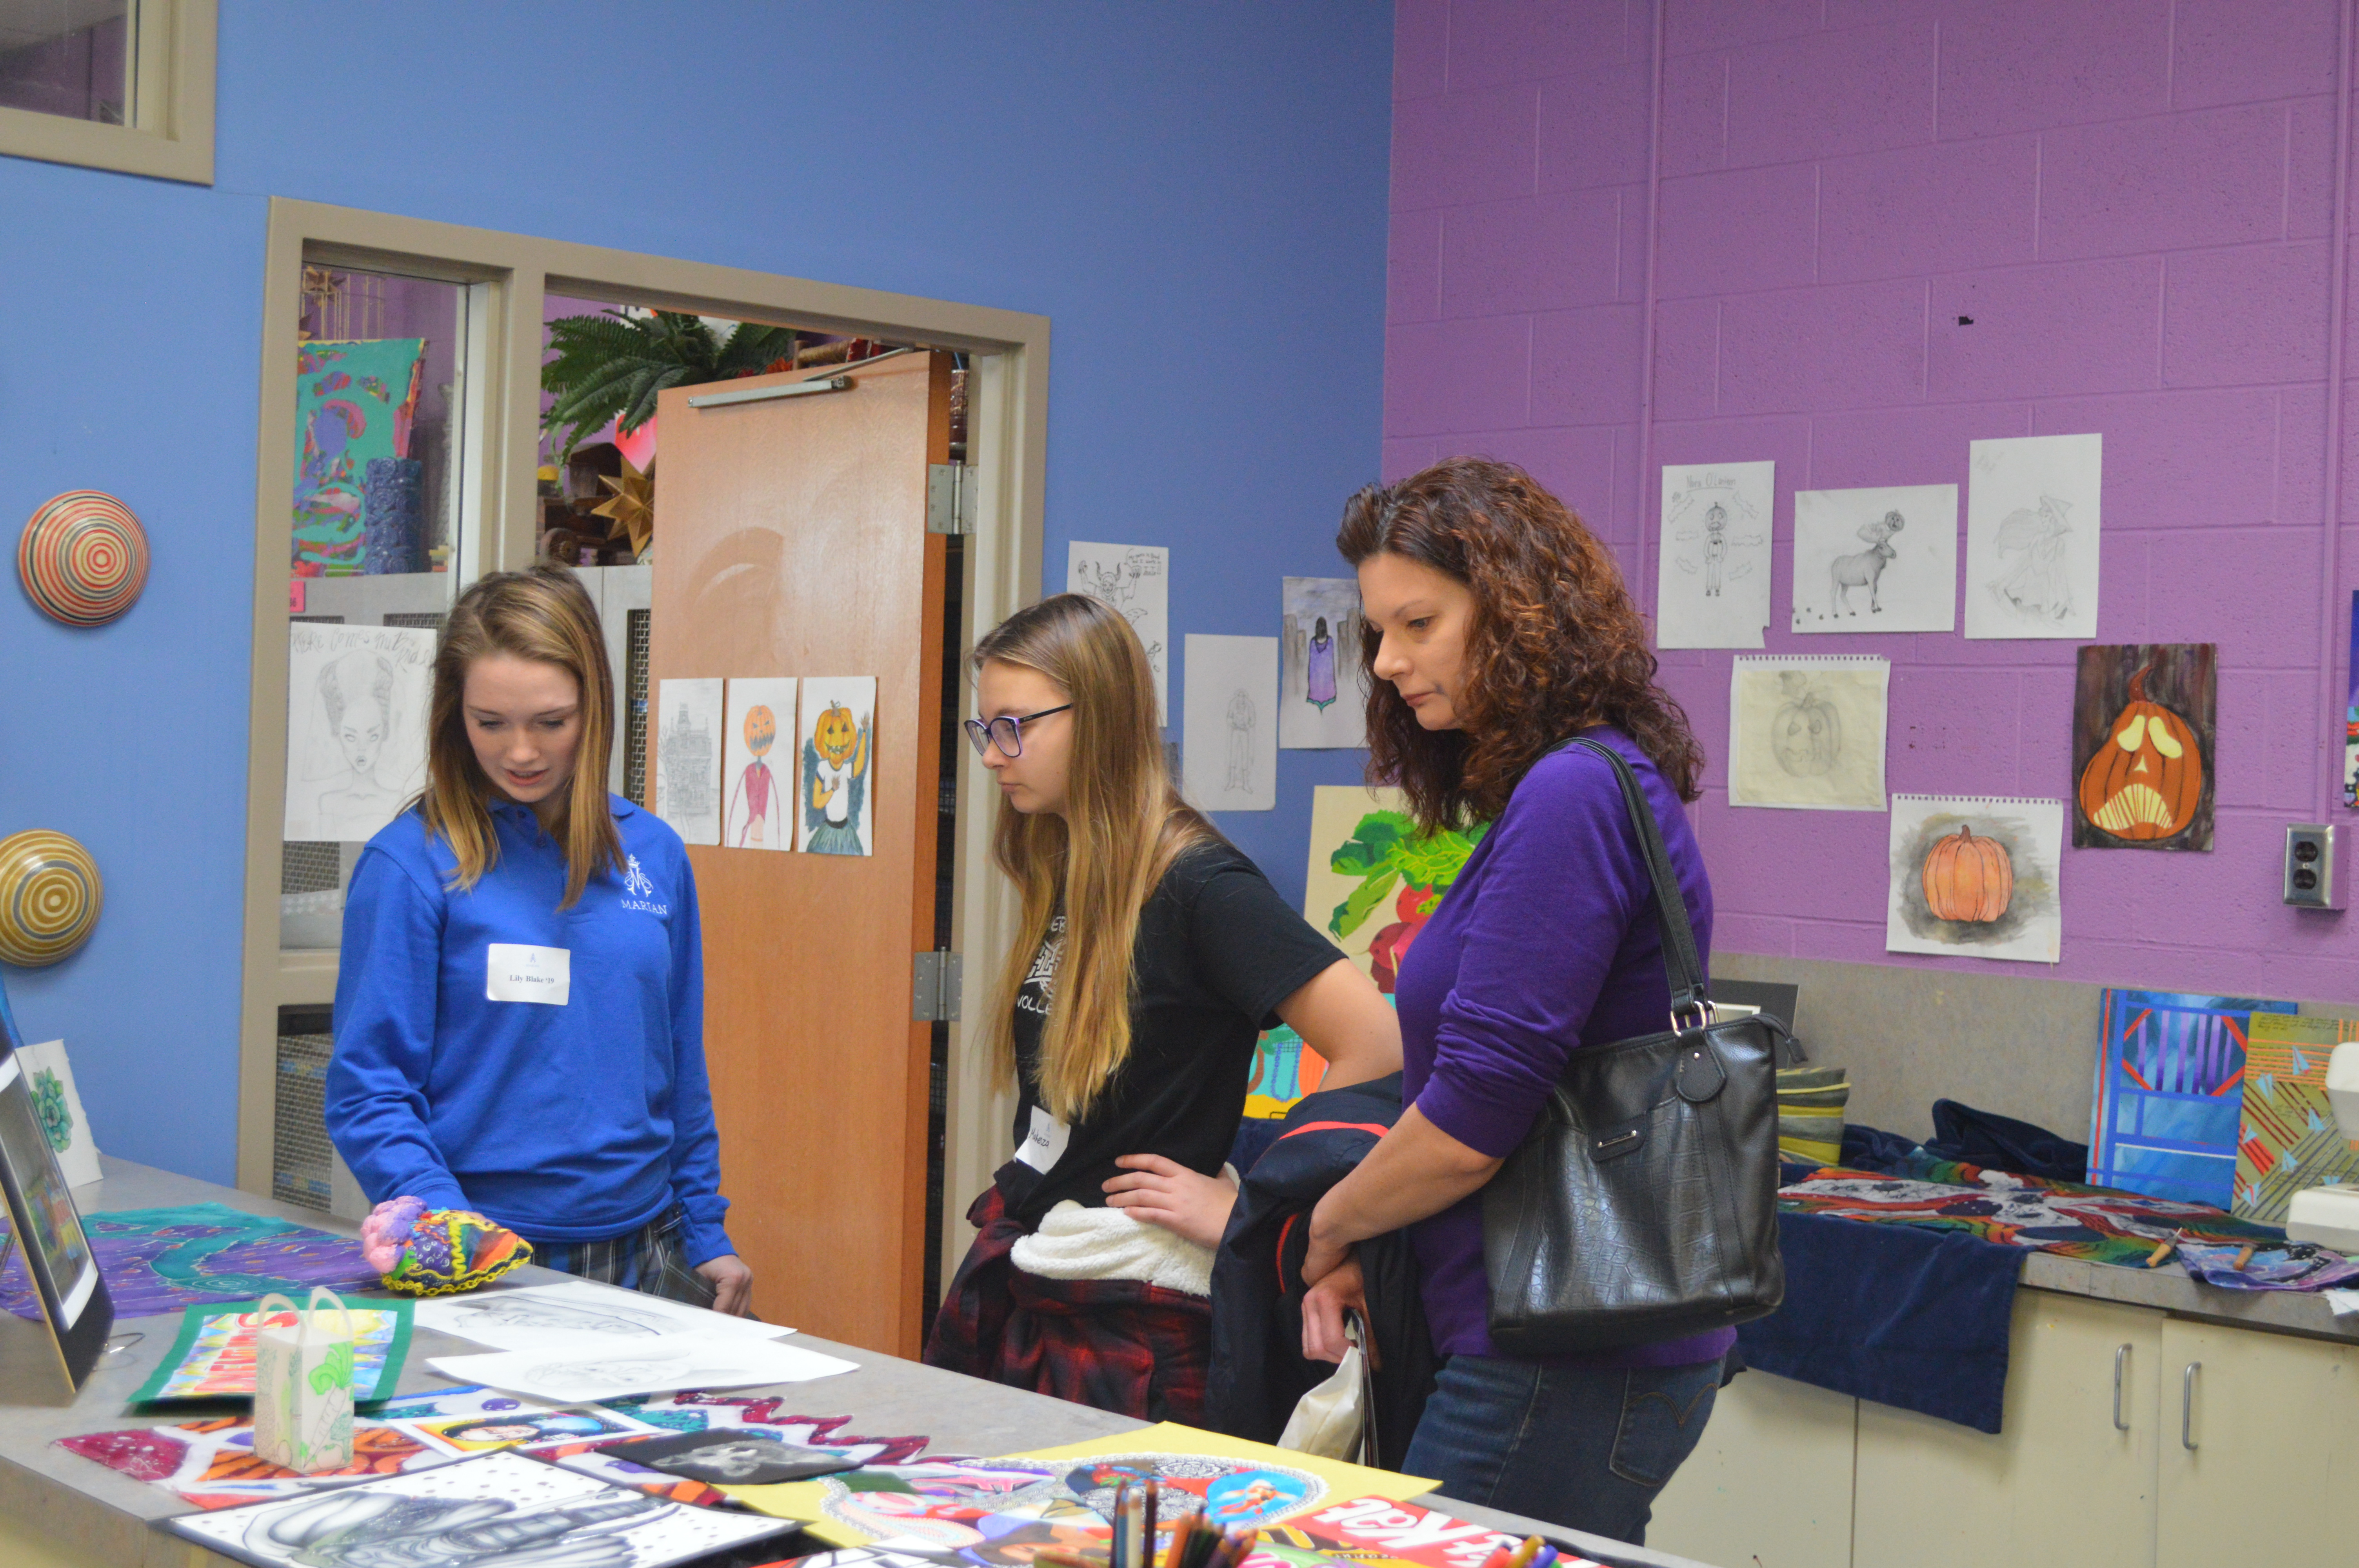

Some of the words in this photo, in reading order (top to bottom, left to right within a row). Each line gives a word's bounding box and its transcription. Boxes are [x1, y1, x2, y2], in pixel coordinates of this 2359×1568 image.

[621, 898, 667, 915] MARIAN
[509, 975, 523, 983] Lily
[1312, 1498, 1492, 1548] Kat
